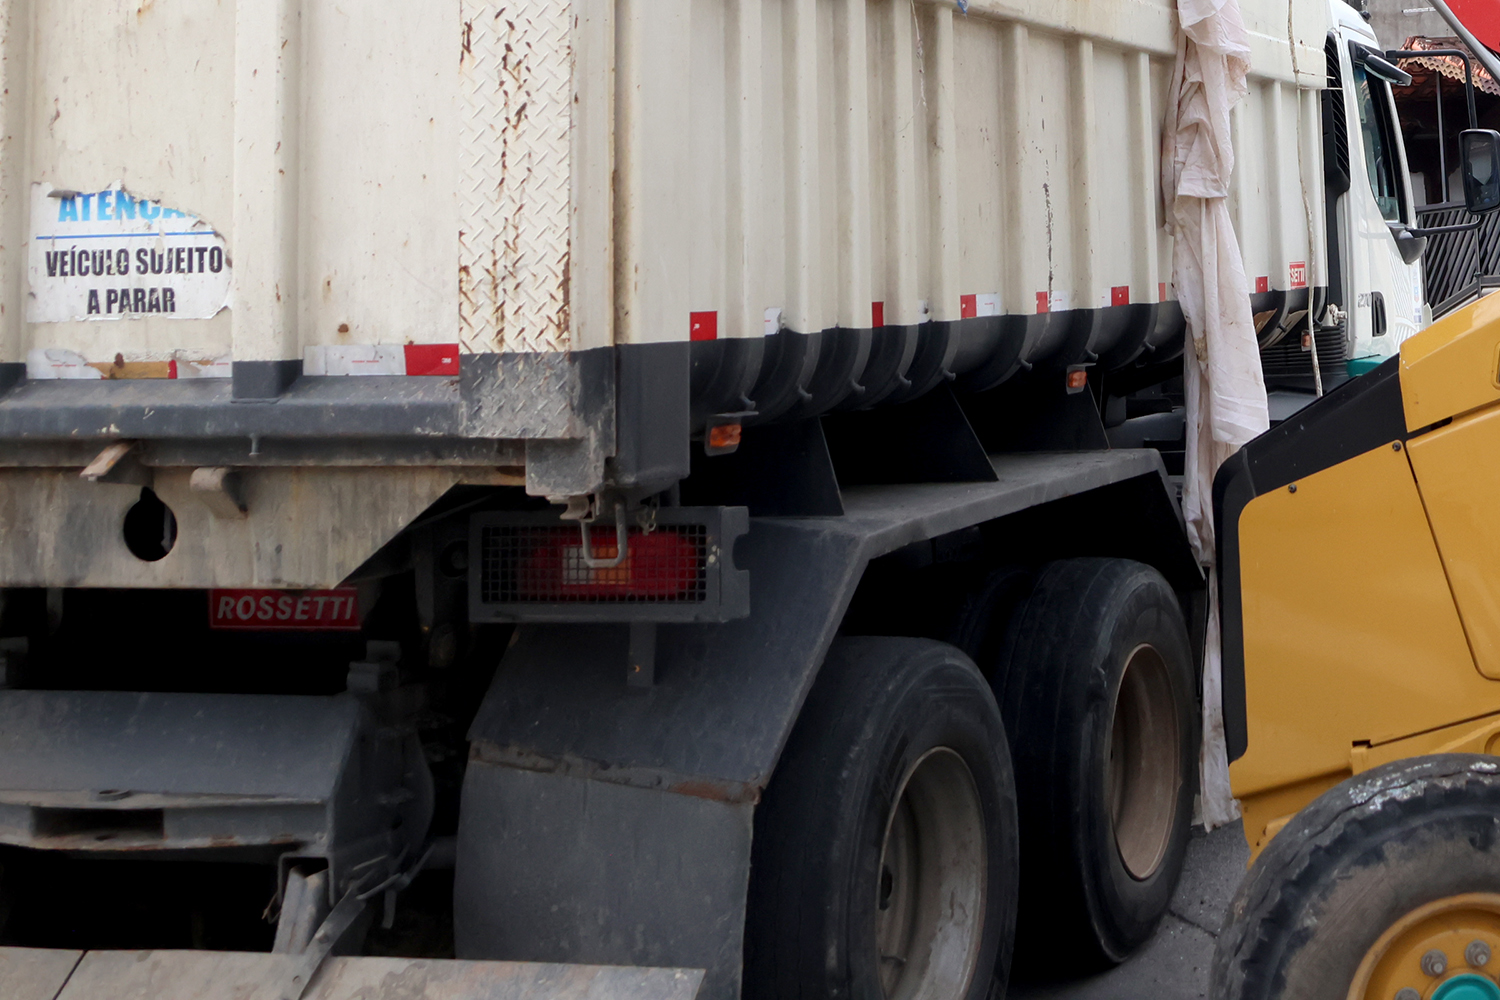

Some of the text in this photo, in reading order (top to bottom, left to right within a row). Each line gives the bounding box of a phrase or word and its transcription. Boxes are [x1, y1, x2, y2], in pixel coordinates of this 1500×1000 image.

[58, 189, 198, 225] ATENÇ
[45, 245, 223, 277] VEÍCULO SUJEITO
[87, 288, 176, 315] A PARAR
[217, 595, 354, 621] ROSSETTI
